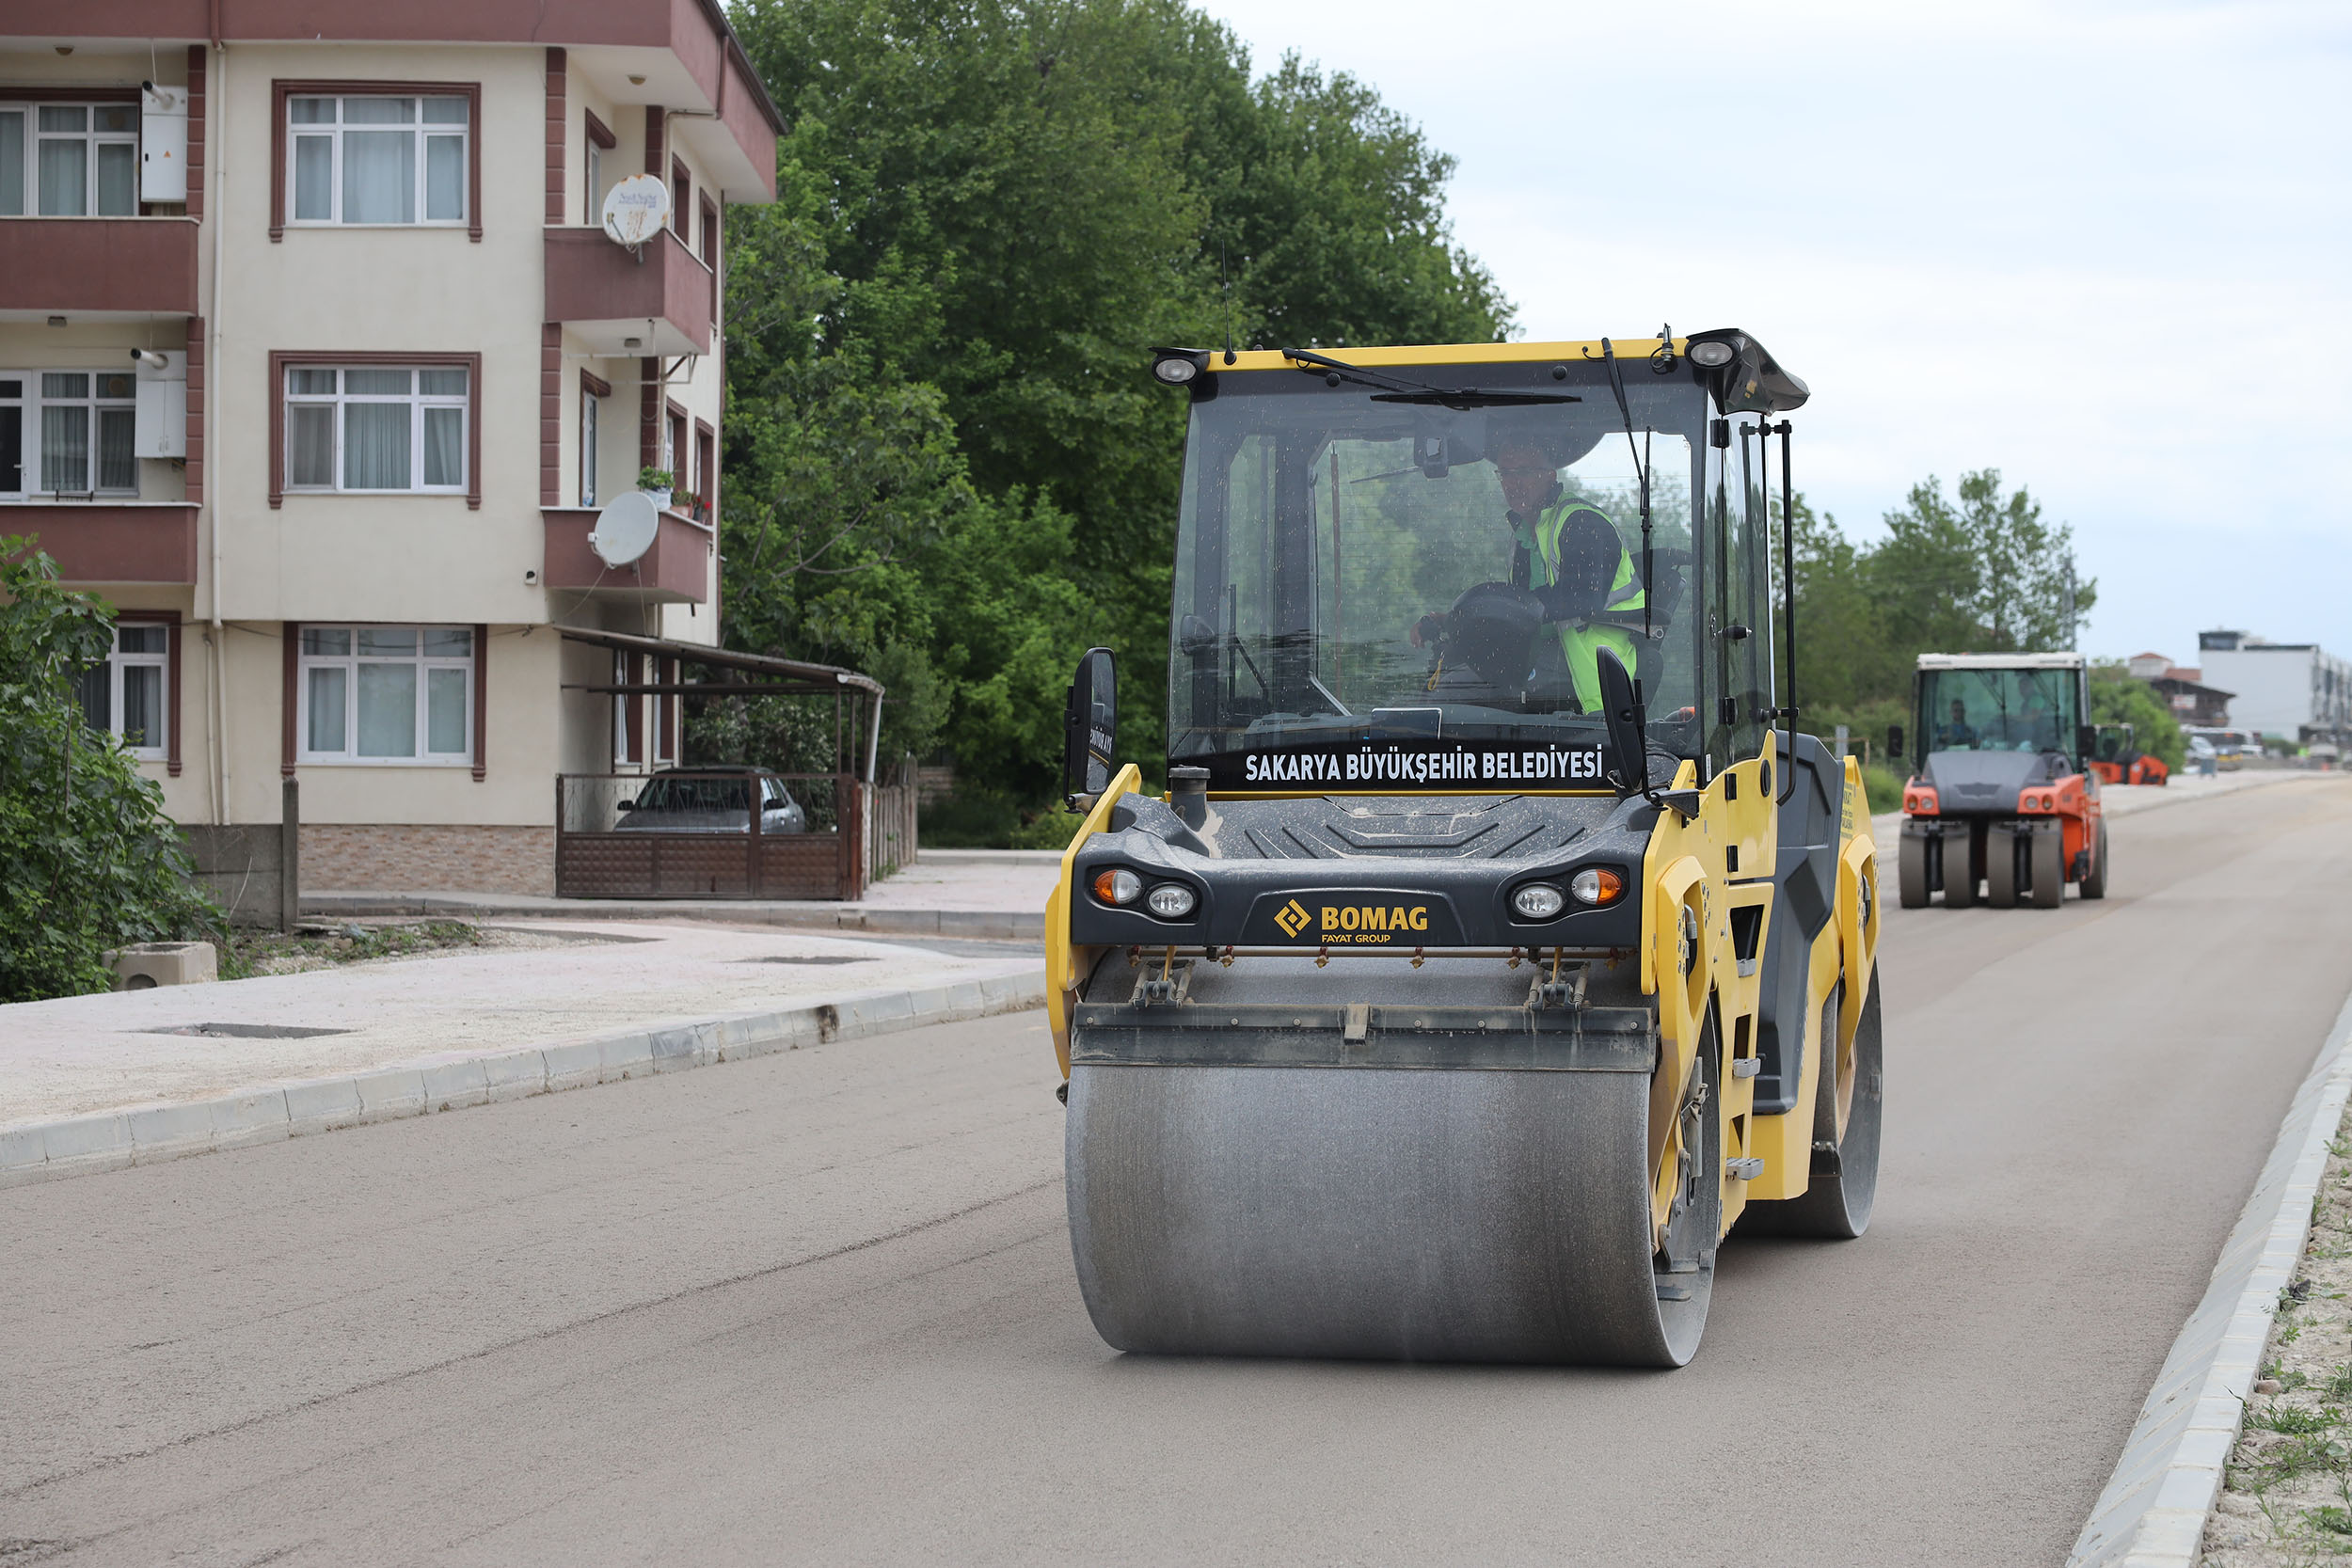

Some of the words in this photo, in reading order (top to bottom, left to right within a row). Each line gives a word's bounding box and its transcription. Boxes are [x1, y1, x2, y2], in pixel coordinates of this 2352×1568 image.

[1245, 753, 1342, 781] SAKARYA
[1345, 745, 1477, 784] BÜYÜKŞEHİR
[1483, 743, 1603, 779] BELEDİYESİ
[1321, 906, 1428, 931] BOMAG
[1321, 934, 1352, 943] FAYAT
[1355, 934, 1391, 943] GROUP
